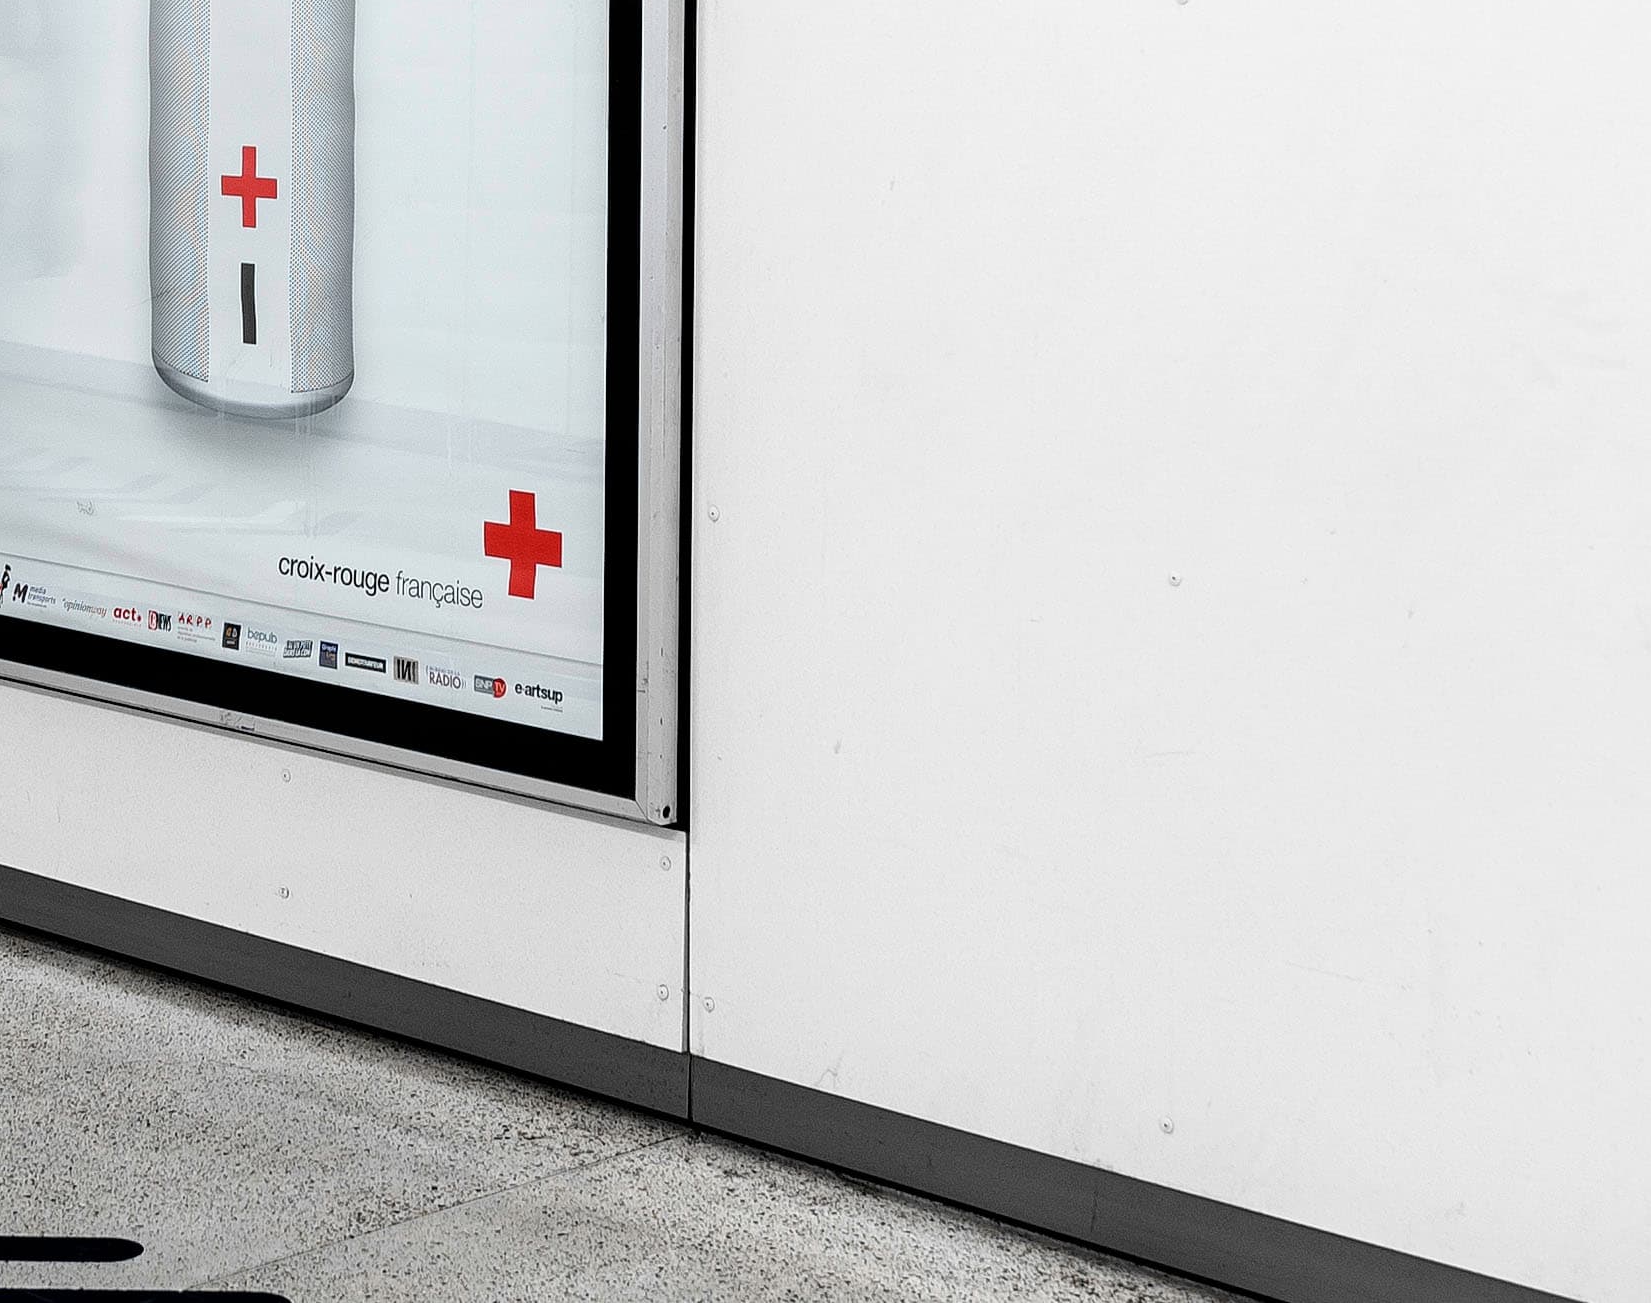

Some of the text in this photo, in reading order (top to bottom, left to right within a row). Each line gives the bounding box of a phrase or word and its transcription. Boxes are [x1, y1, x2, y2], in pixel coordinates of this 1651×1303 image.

[278, 556, 483, 609] croix-rouge française
[429, 671, 461, 689] RADIO
